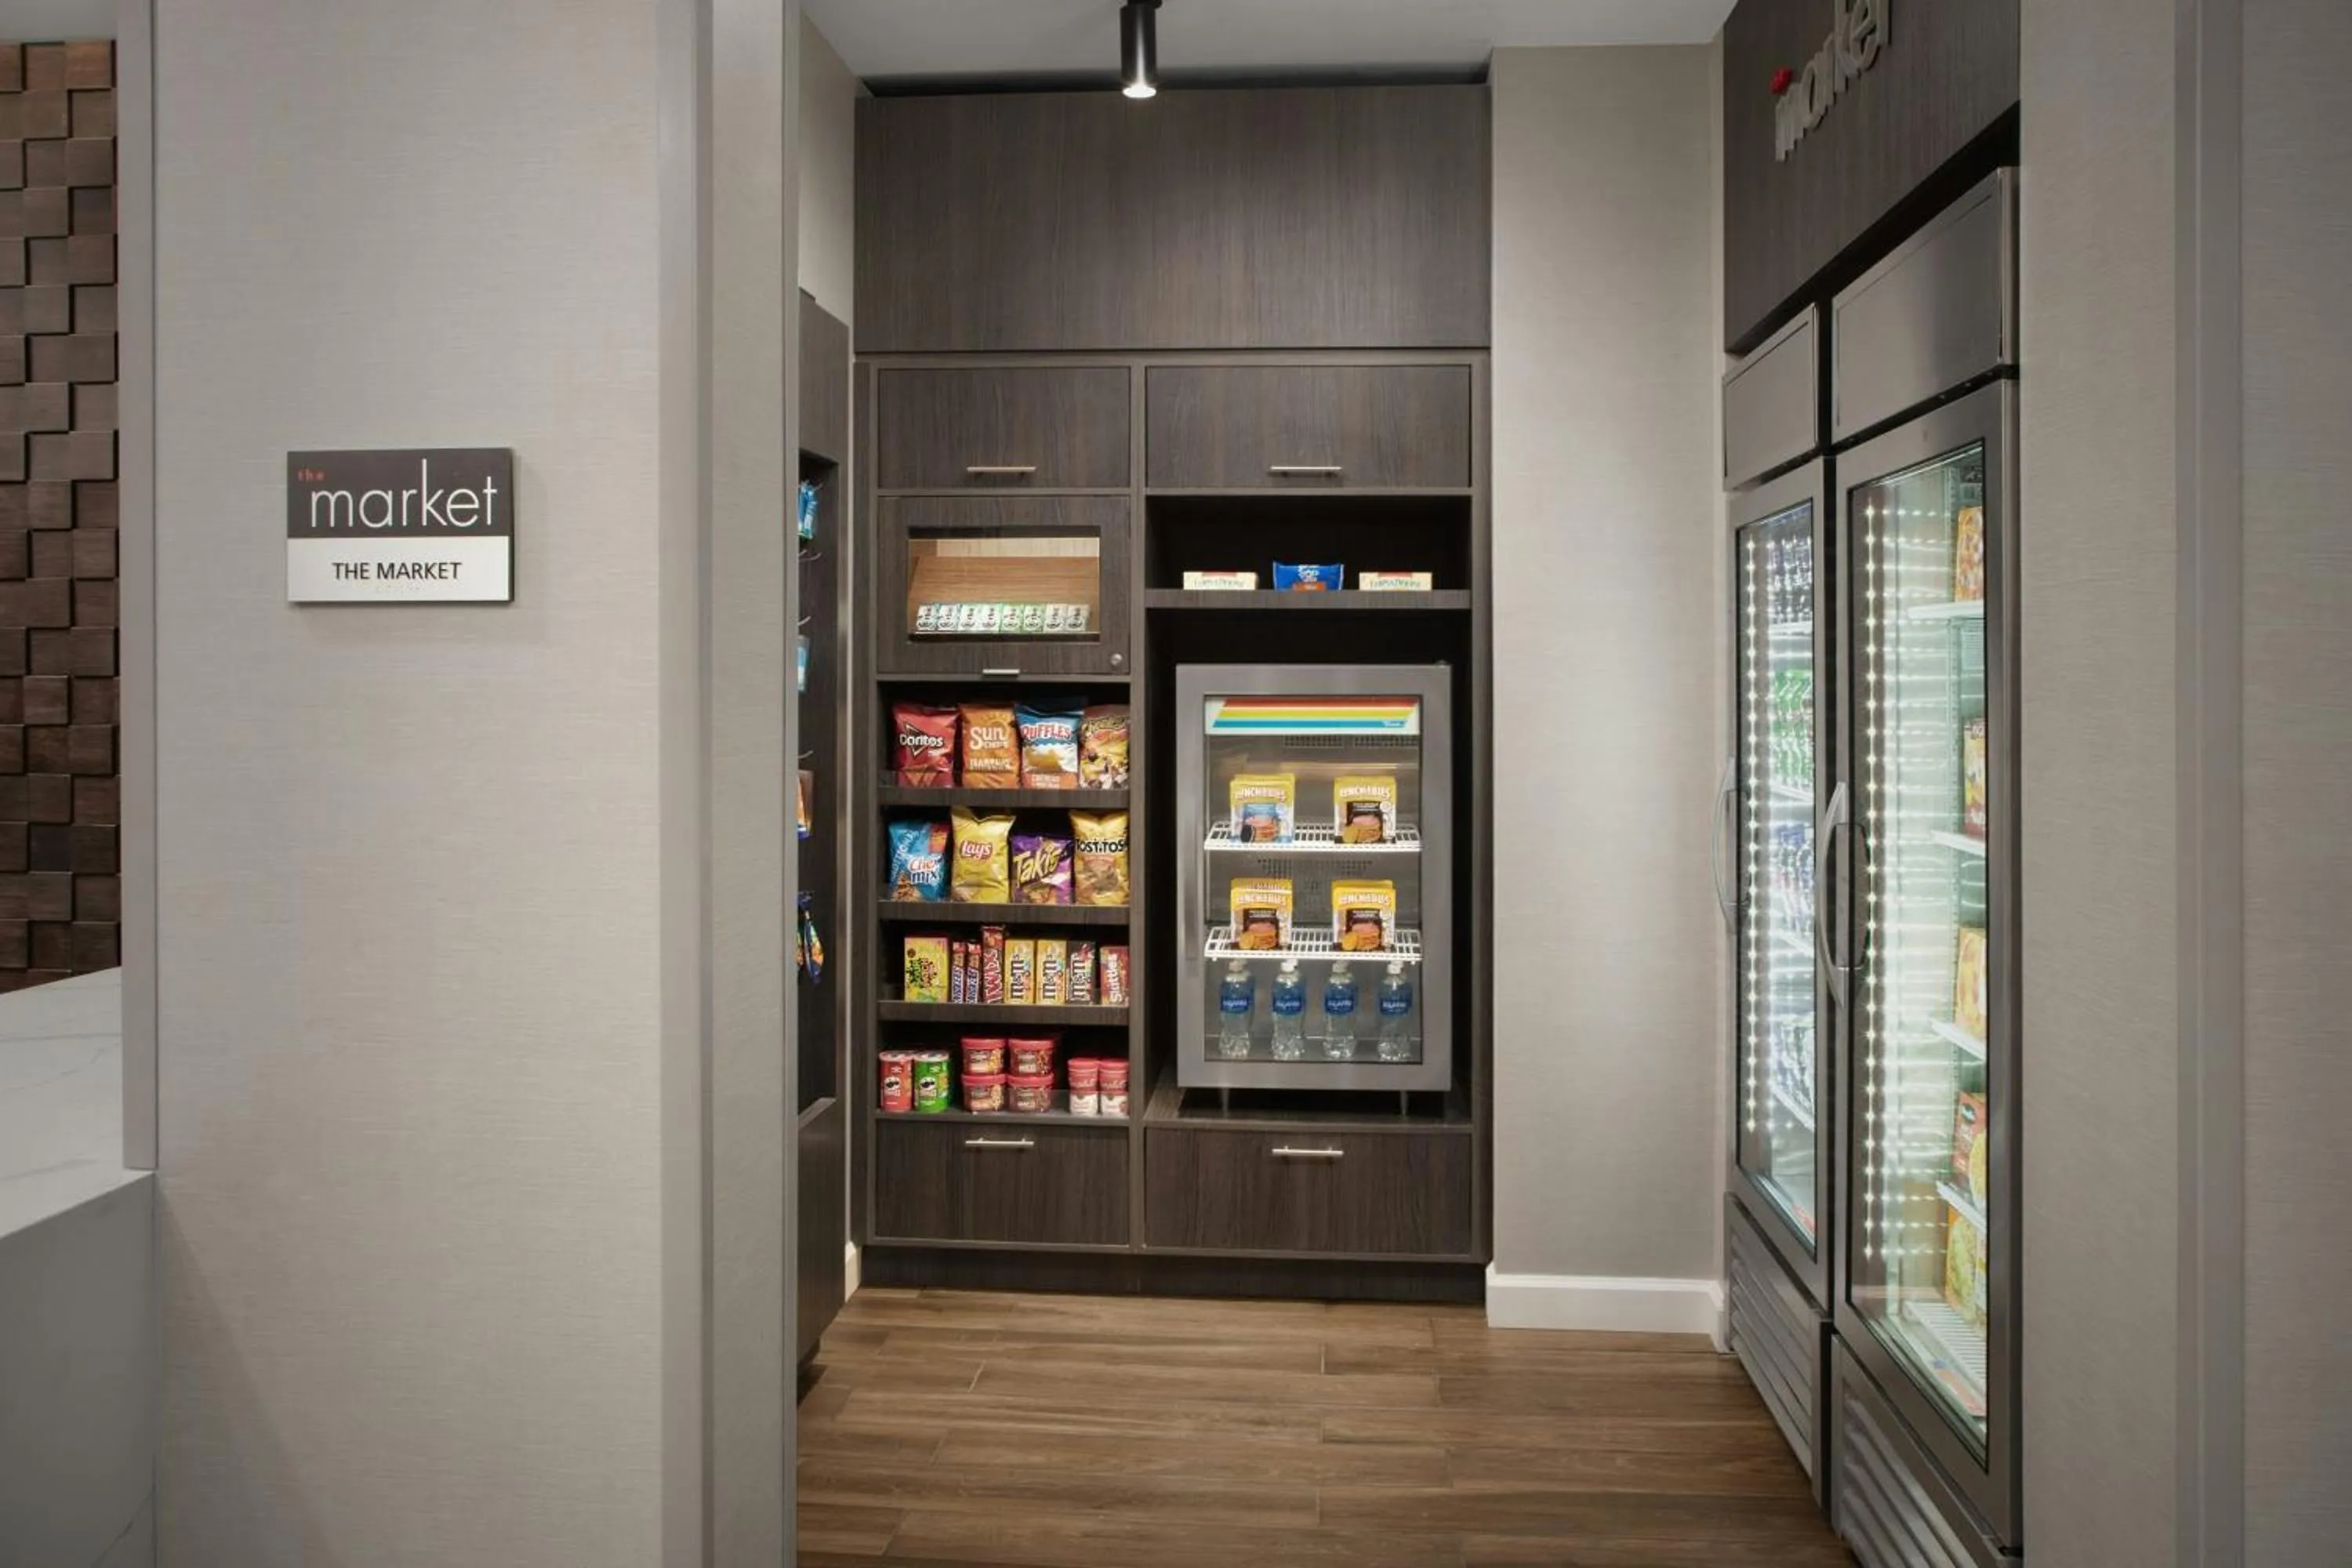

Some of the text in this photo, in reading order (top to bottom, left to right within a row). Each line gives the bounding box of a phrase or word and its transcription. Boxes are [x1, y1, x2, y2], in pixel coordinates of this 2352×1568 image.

[298, 468, 325, 481] the
[311, 458, 498, 528] market
[332, 562, 463, 580] THE MARKET
[899, 734, 944, 747] Doritos
[970, 726, 1007, 750] Sun
[1013, 843, 1062, 887] Takis
